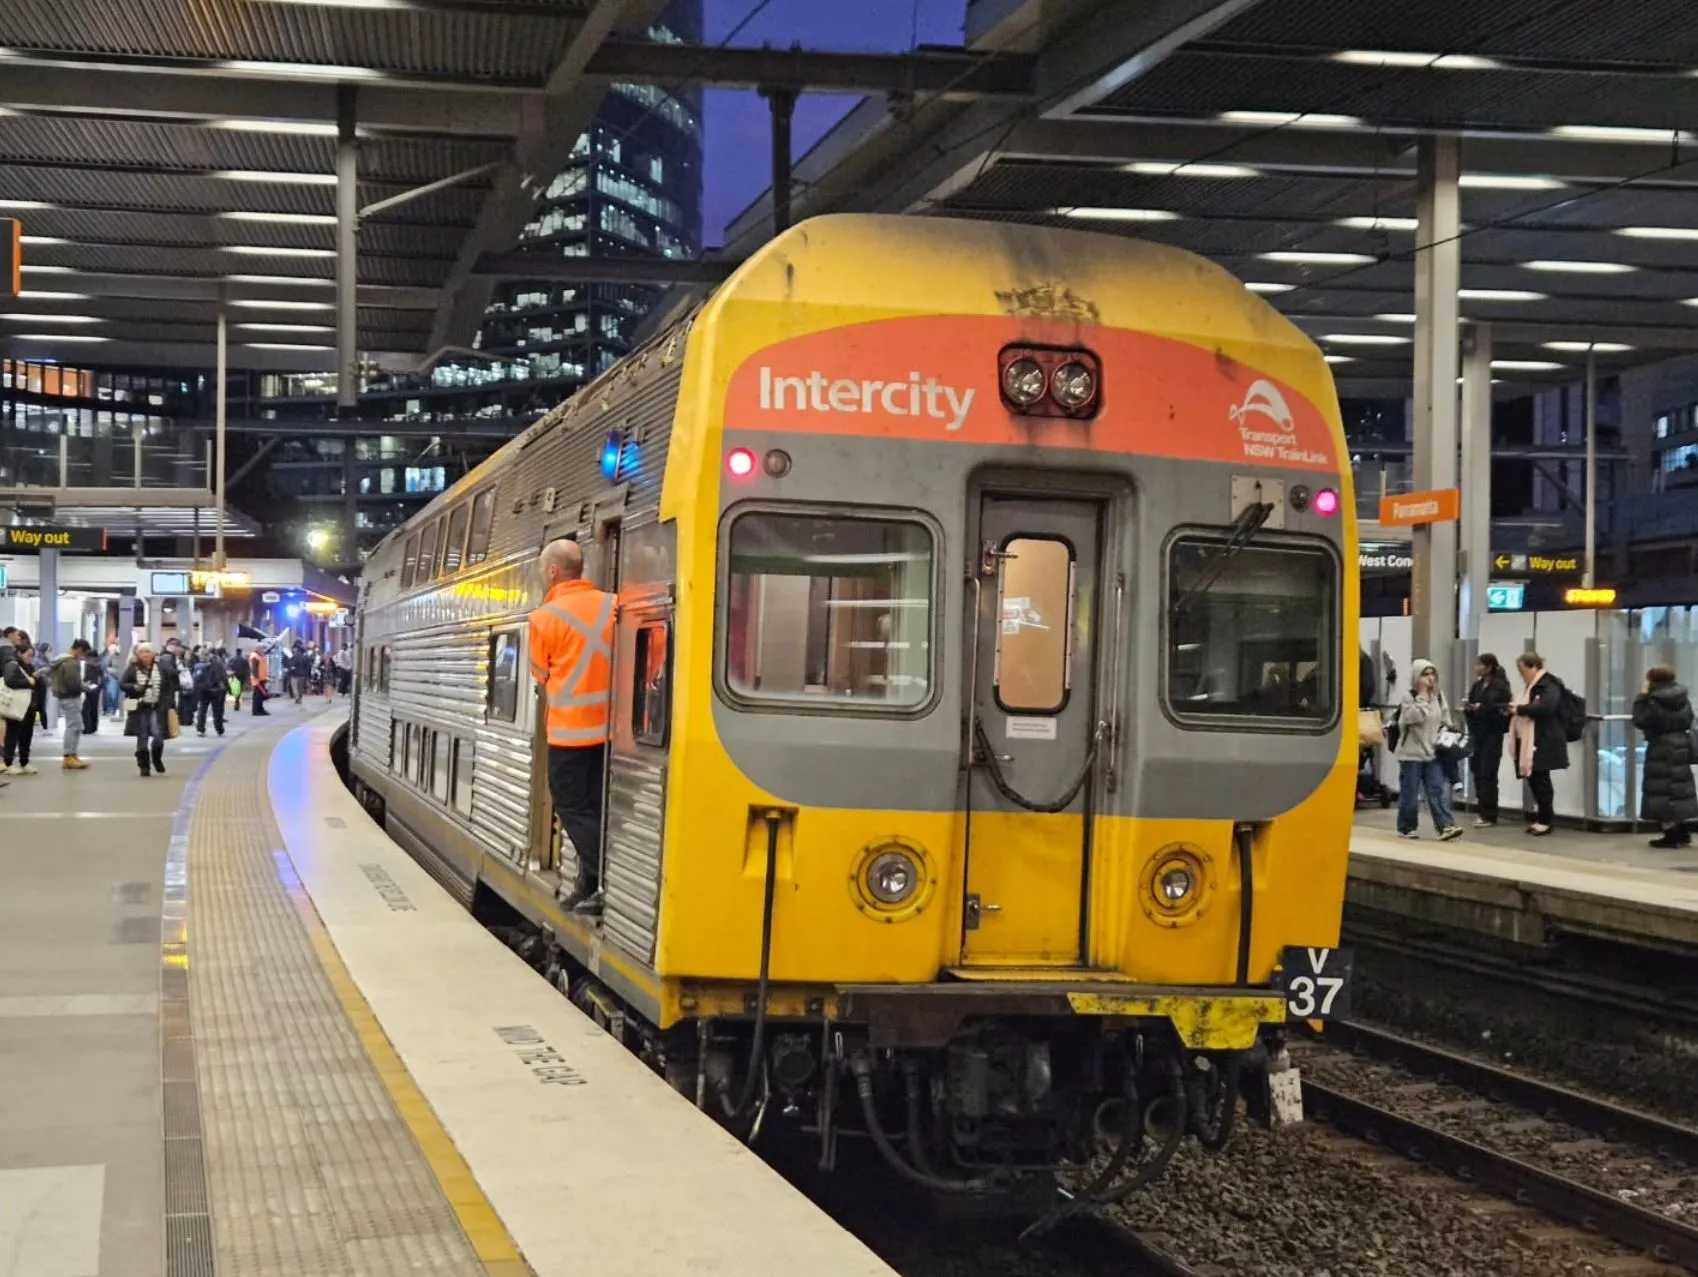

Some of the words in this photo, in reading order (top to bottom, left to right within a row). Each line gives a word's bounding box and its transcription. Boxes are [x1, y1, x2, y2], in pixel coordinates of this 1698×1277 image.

[759, 366, 976, 431] Intercity
[10, 529, 42, 546] Way
[44, 531, 71, 544] out
[1529, 556, 1554, 571] Way
[1555, 559, 1577, 569] out
[1307, 948, 1329, 974] V
[1288, 976, 1344, 1016] 37
